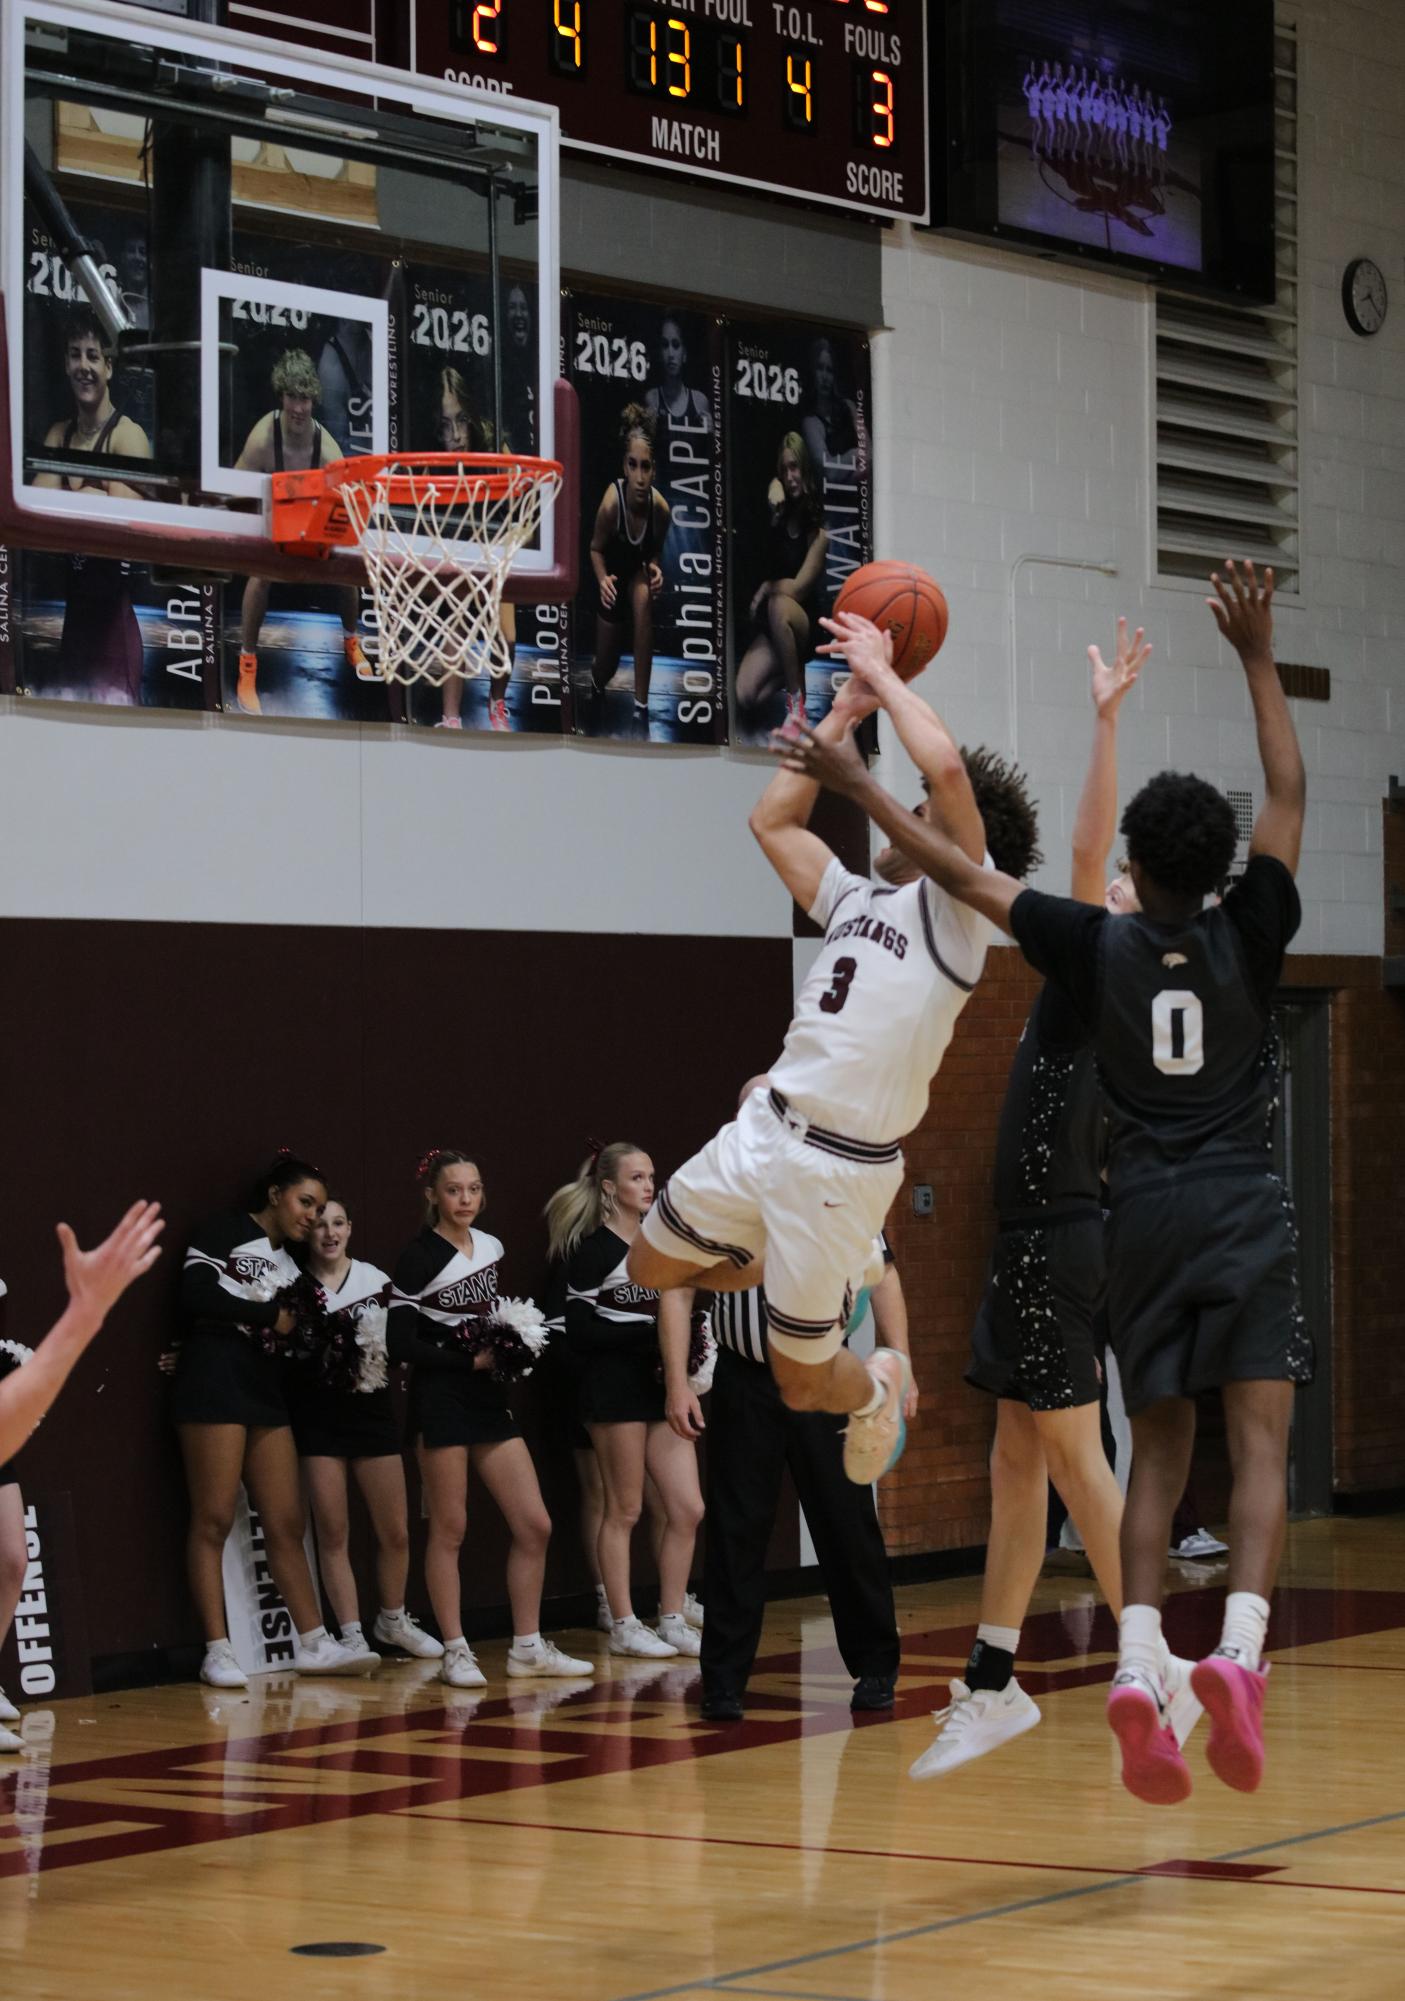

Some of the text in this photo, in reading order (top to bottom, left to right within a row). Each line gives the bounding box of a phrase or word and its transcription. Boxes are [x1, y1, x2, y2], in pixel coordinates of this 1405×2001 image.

[553, 0, 581, 67] 4
[772, 3, 823, 46] T.O.L.
[844, 23, 901, 66] FOULS
[650, 18, 691, 98] 13
[787, 55, 811, 122] 4
[872, 71, 893, 147] 3
[651, 116, 720, 162] MATCH
[846, 161, 904, 204] SCORE
[27, 251, 122, 303] 206
[230, 257, 270, 278] Senior
[414, 283, 453, 305] Senior
[411, 303, 492, 356] 2026
[577, 312, 613, 332] Senior
[737, 341, 769, 360] Senior
[388, 313, 398, 406] WRESTLING
[574, 331, 649, 382] 2026
[735, 359, 802, 405] 2026
[856, 389, 867, 472] WRESTLING
[712, 365, 723, 710] SALINA CENTRAL HIGH SCHOOL WRESTLING
[822, 449, 863, 592] WAITE
[860, 480, 869, 539] SCHOOL
[667, 413, 717, 725] Sophia CAPE
[205, 603, 215, 665] SALINA
[560, 637, 570, 694] SALINA
[819, 956, 858, 1014] 3
[1152, 989, 1204, 1075] 0
